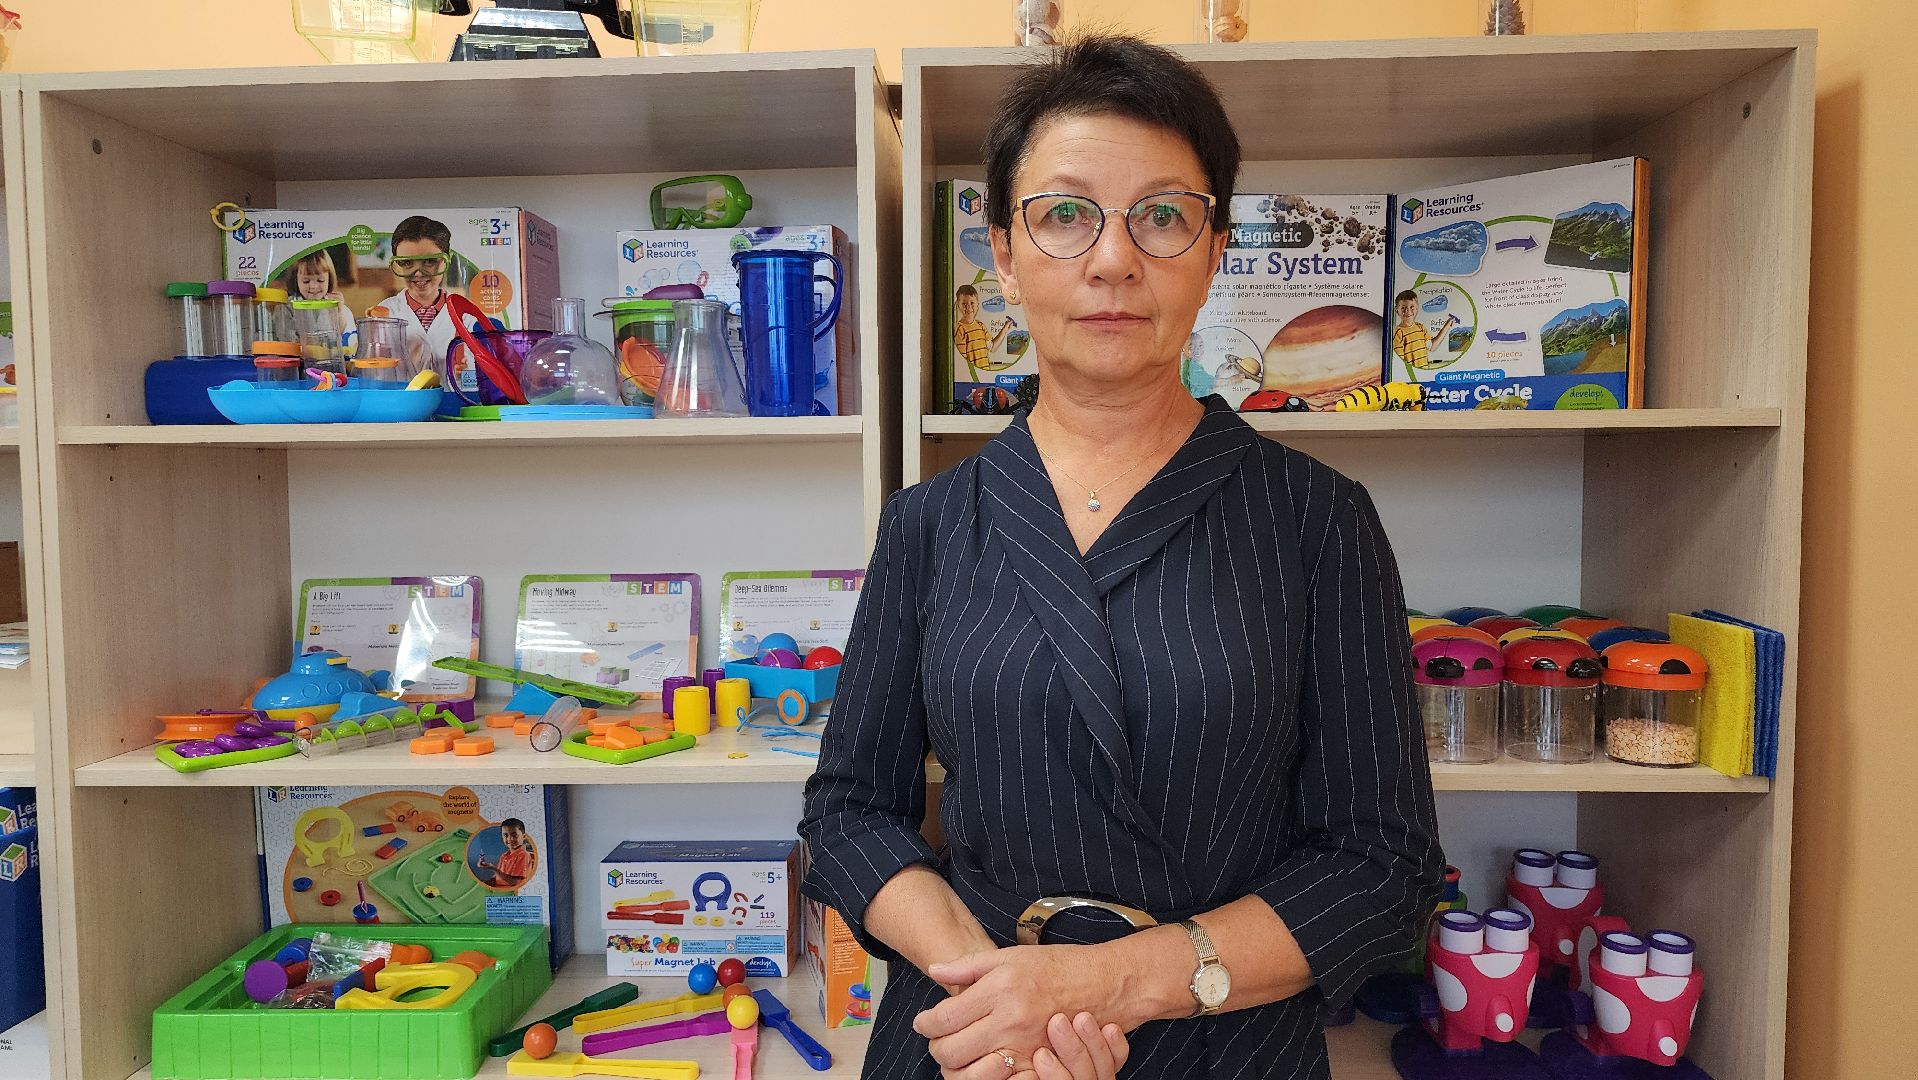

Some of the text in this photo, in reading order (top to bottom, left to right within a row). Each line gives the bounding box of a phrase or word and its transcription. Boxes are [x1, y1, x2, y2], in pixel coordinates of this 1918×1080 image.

[1427, 194, 1473, 207] Learning
[1426, 203, 1481, 217] Resources
[259, 220, 304, 230] Learning
[490, 218, 510, 234] 3+
[259, 231, 312, 239] Resources
[1231, 229, 1301, 245] Magnetic
[647, 240, 689, 249] Learning
[806, 234, 827, 250] 3+
[647, 250, 697, 258] Resources
[239, 256, 257, 269] 22
[1216, 252, 1363, 281] lar System
[482, 274, 499, 287] 10
[1000, 376, 1018, 385] Giant
[1439, 370, 1500, 381] Giant Magnetic
[1474, 384, 1533, 402] Cycle
[411, 587, 463, 598] STEM
[532, 587, 576, 598] Moving Midway
[630, 583, 682, 594] STEM
[319, 591, 329, 601] Big
[524, 784, 536, 793] 5+
[625, 870, 657, 879] Learning
[767, 872, 782, 884] 5+
[631, 957, 716, 969] Super Magnet Lab
